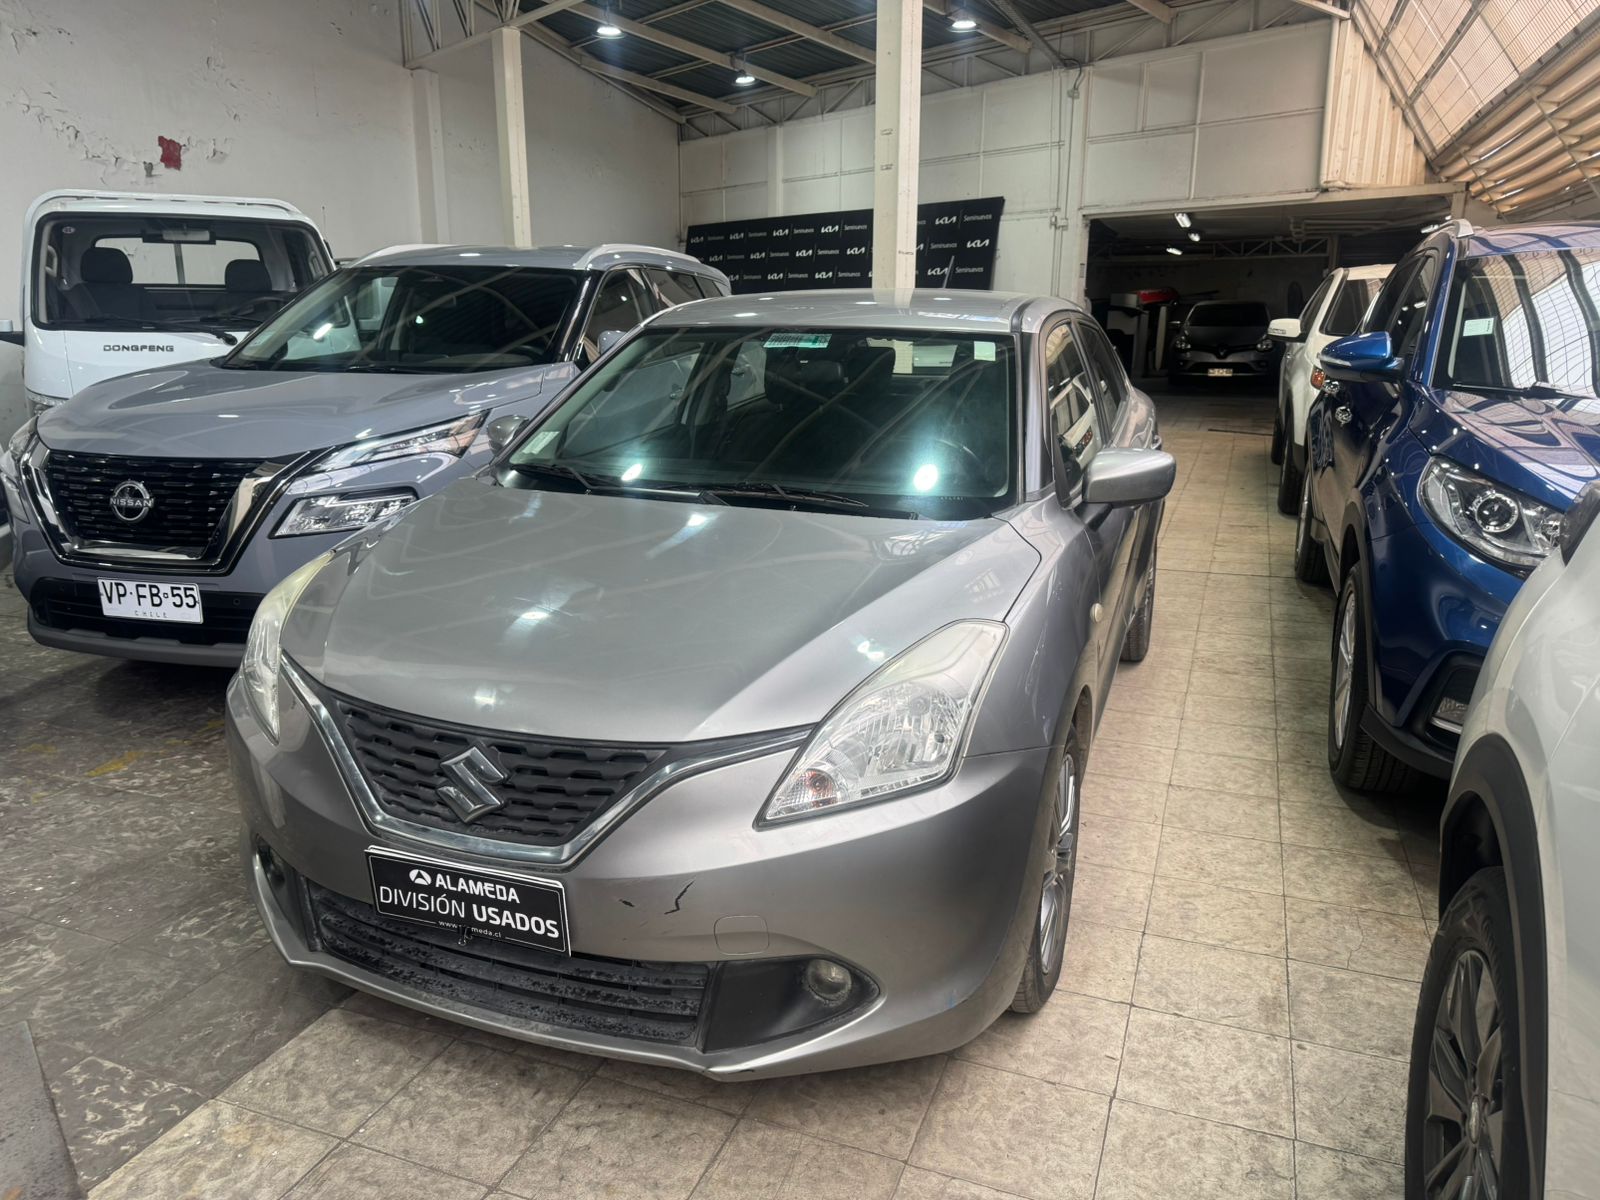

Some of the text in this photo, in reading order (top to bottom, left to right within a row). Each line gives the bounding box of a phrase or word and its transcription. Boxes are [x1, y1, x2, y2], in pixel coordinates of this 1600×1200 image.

[103, 344, 174, 352] DONGFENG
[110, 497, 154, 508] NISSAN
[135, 610, 167, 618] CHILE
[435, 873, 521, 904] ALAMEDA
[380, 886, 560, 938] DIVISIÓN USADOS
